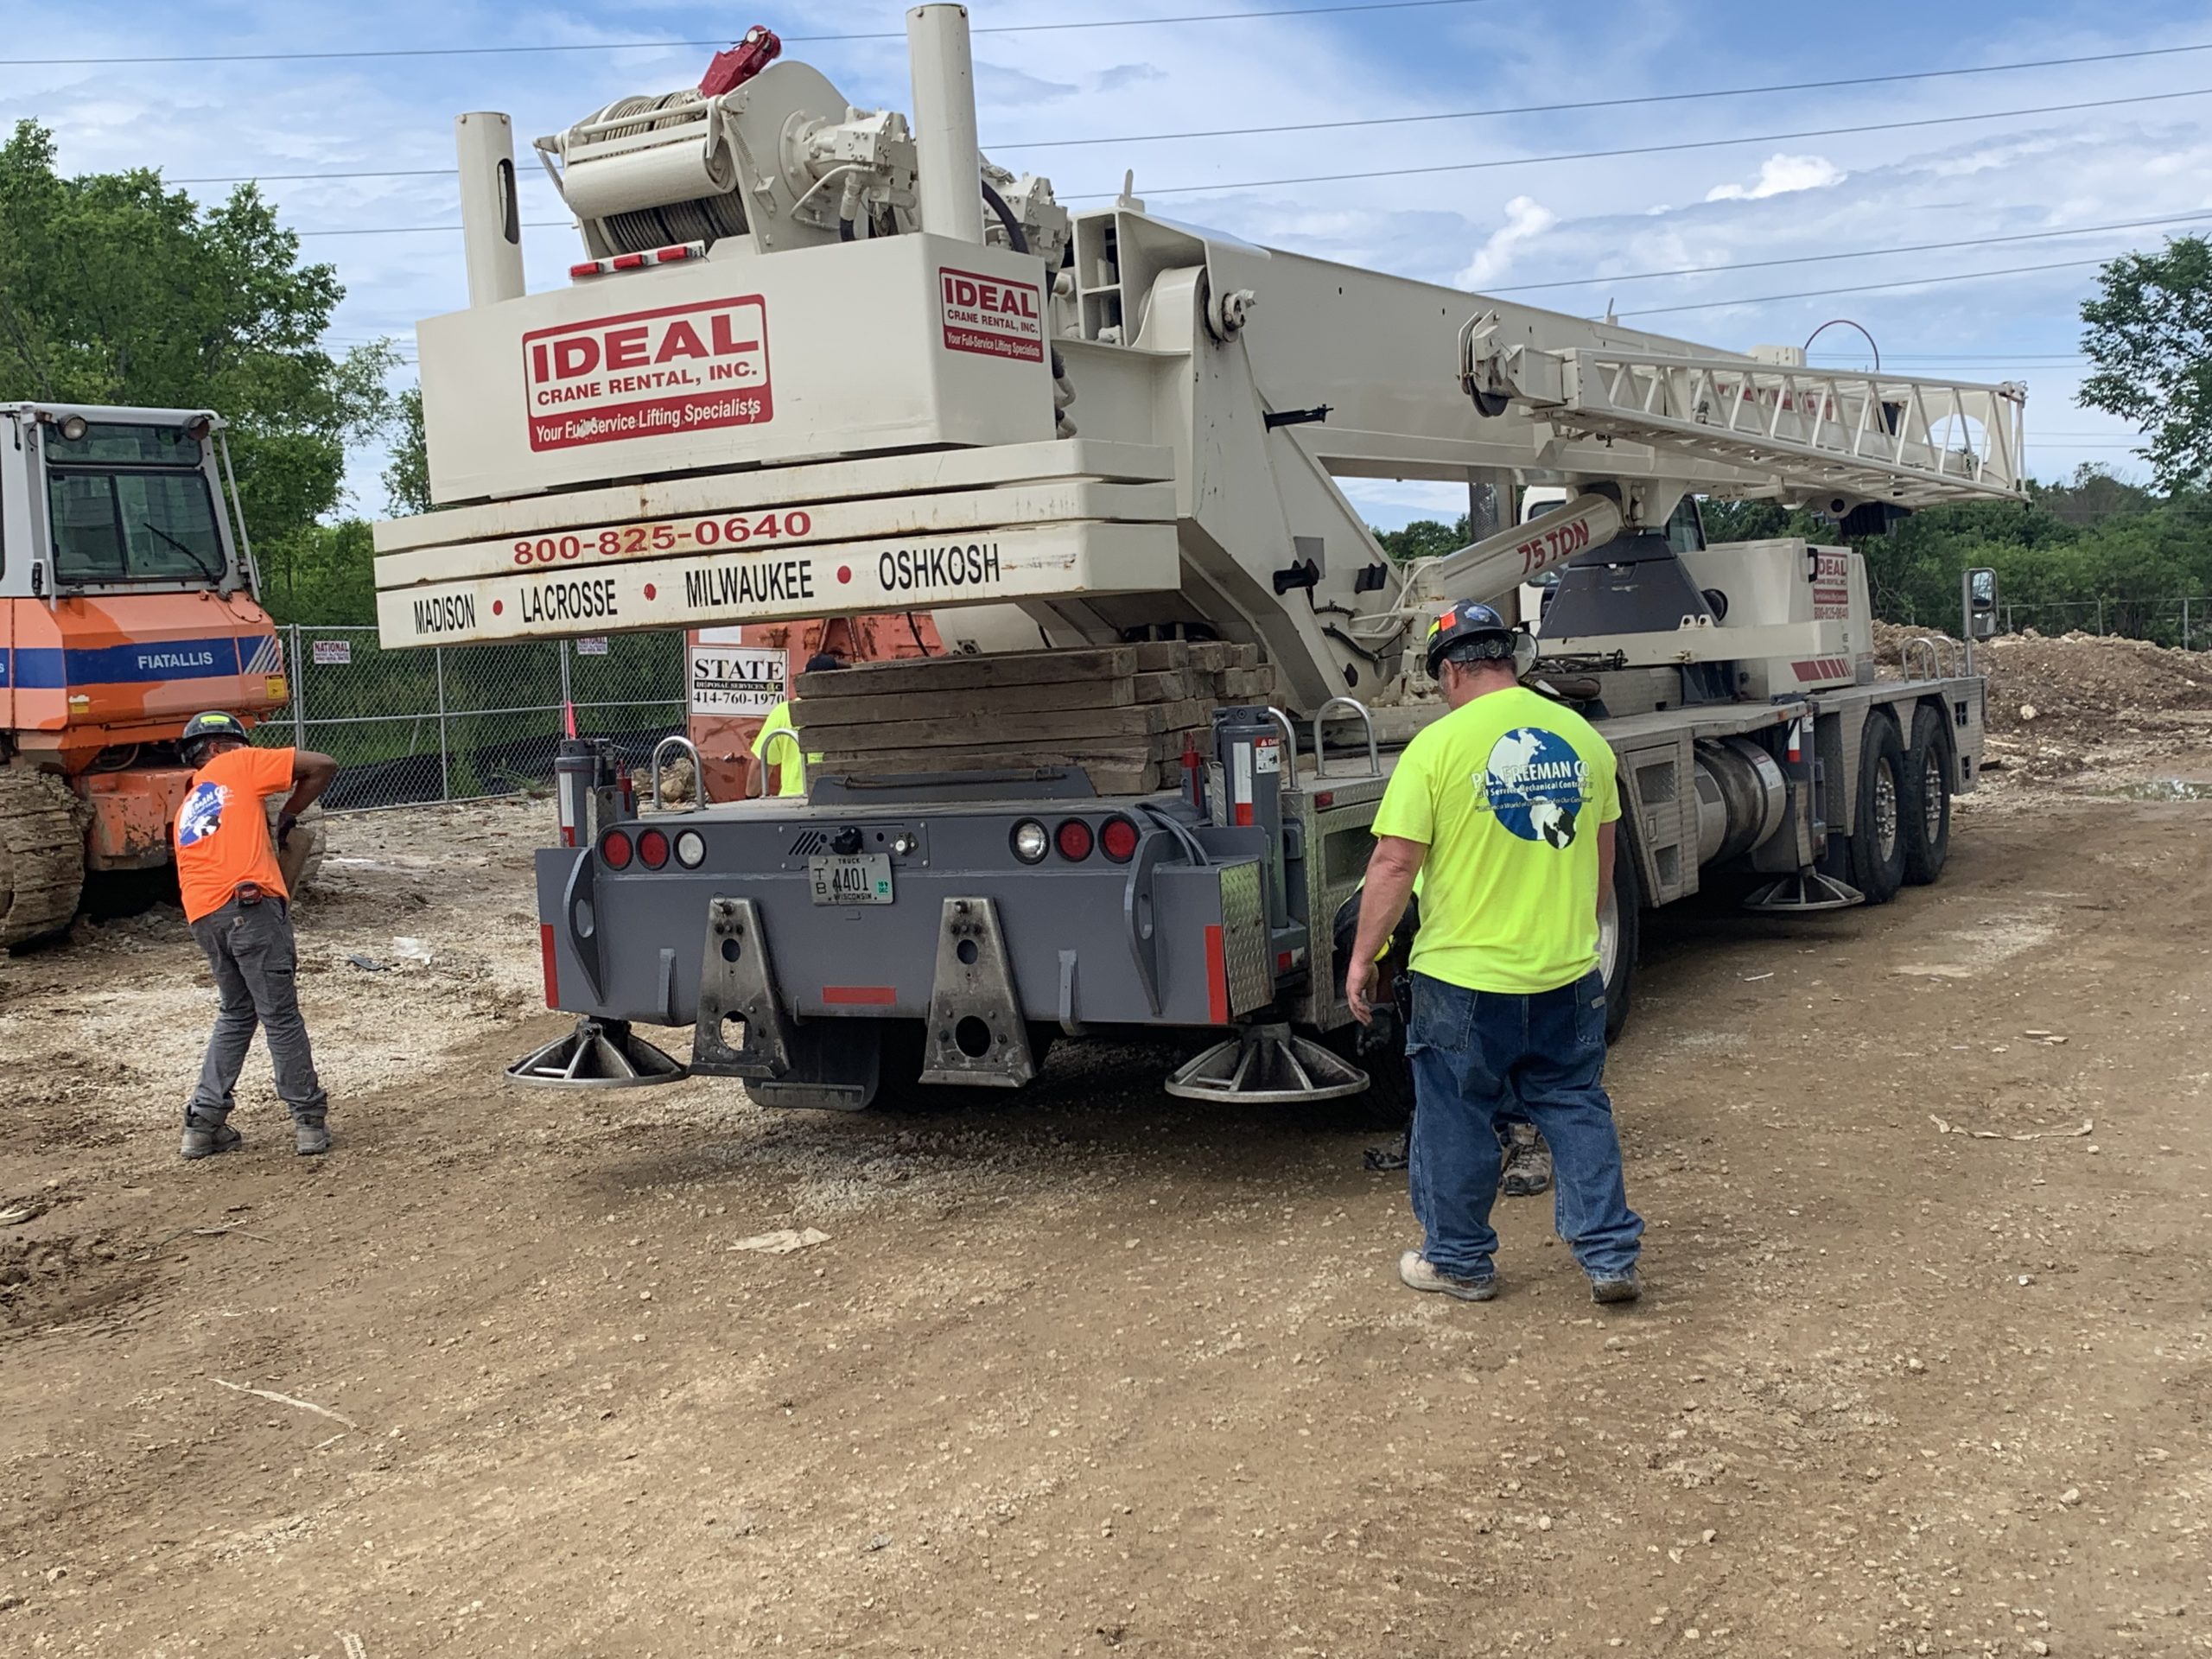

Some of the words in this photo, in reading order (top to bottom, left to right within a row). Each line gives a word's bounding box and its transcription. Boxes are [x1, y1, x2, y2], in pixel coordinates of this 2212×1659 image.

[944, 277, 1038, 319] IDEAL
[947, 309, 978, 323] CRANE
[982, 315, 1019, 332] RENTAL,
[1020, 321, 1039, 334] INC.
[532, 315, 759, 384] IDEAL
[947, 332, 961, 345] Your
[1012, 341, 1040, 357] Specialists
[537, 382, 601, 406] CRANE
[609, 369, 701, 395] RENTAL,
[709, 361, 758, 381] INC.
[536, 423, 563, 443] Your
[639, 407, 681, 429] Lifting
[684, 397, 761, 424] Specialists
[514, 511, 811, 564] 800-825-0640
[1516, 539, 1546, 575] 75
[1545, 518, 1589, 561] TON
[1816, 558, 1847, 576] DEAL
[414, 594, 476, 635] MADISON
[520, 579, 618, 624] LACROSSE
[685, 560, 814, 608] MILWAUKEE
[878, 543, 1001, 592] OSHKOSH
[137, 652, 213, 671] FIATALLIS
[694, 658, 784, 681] STATE
[694, 691, 785, 705] 414-760-1970
[1502, 761, 1572, 785] FREEMAN
